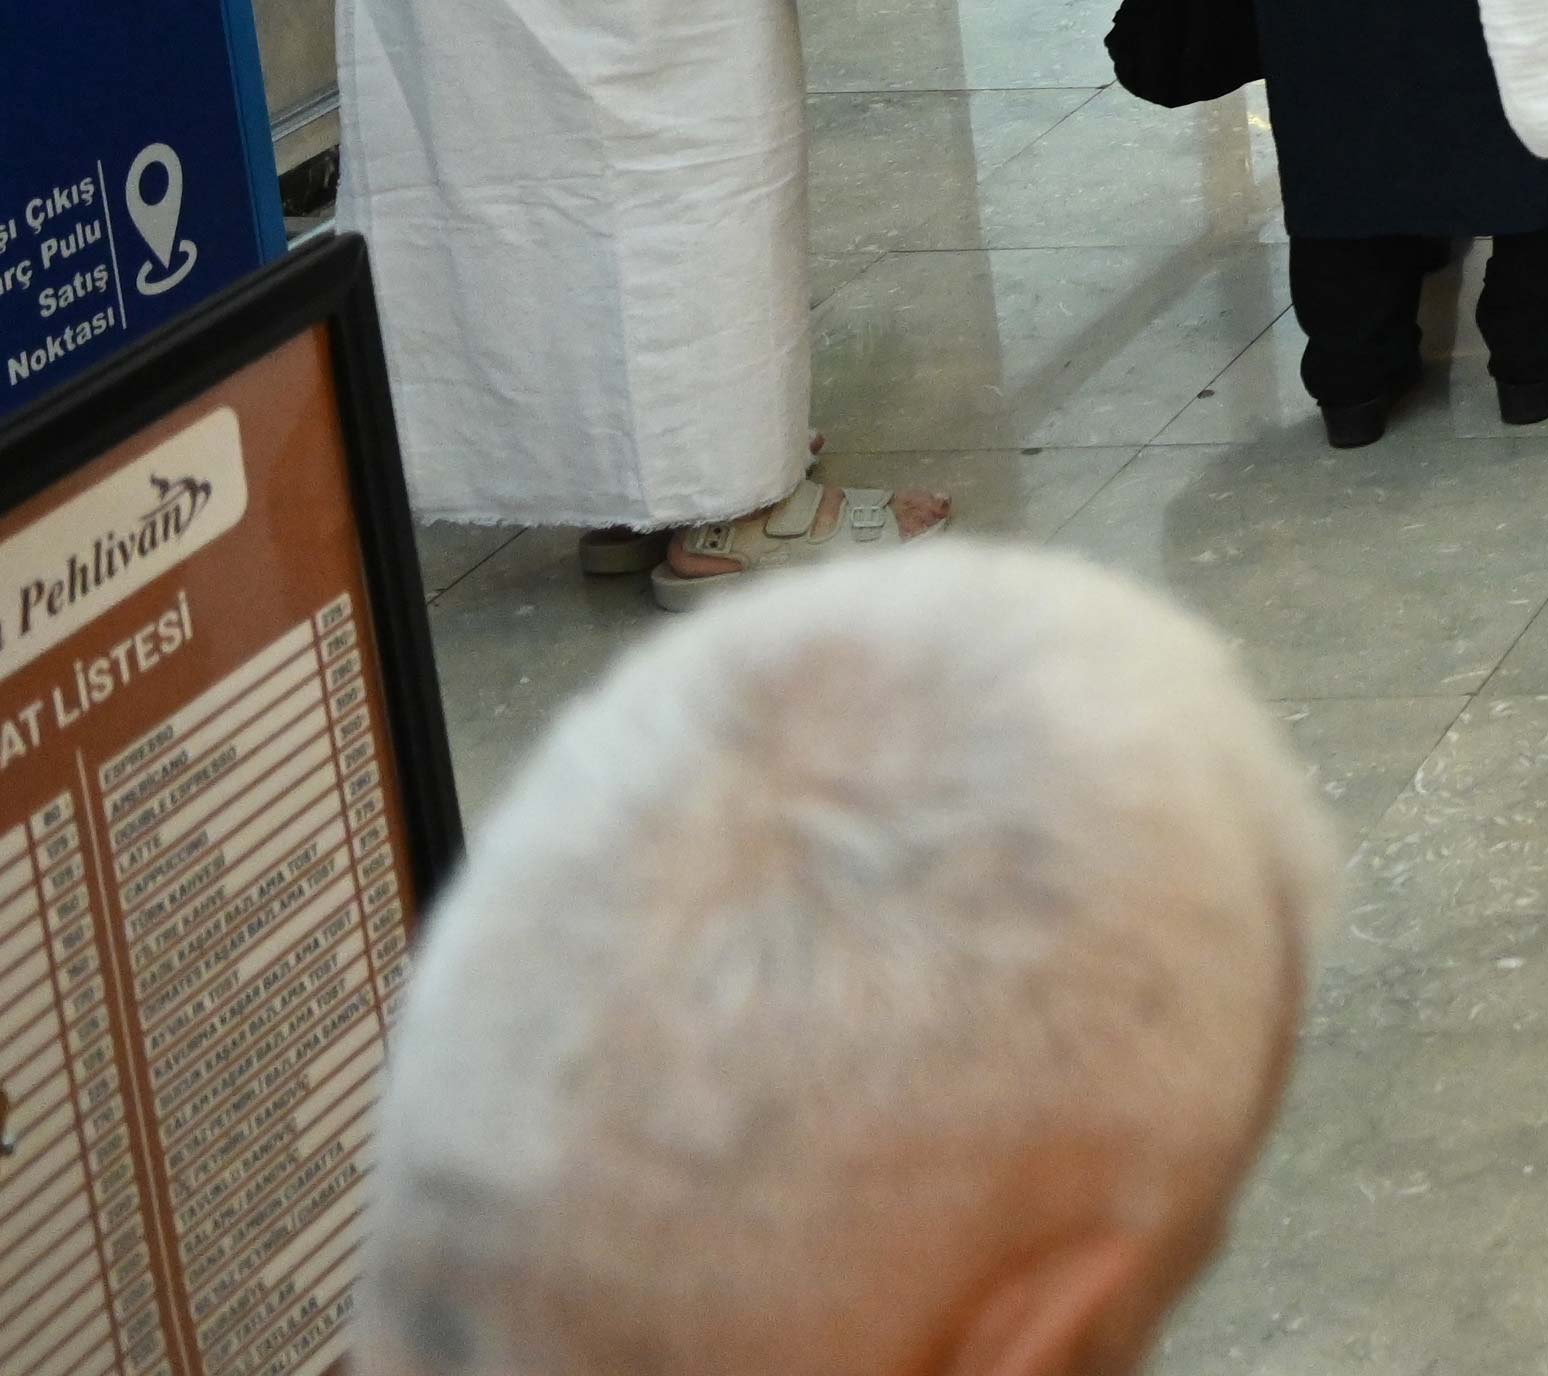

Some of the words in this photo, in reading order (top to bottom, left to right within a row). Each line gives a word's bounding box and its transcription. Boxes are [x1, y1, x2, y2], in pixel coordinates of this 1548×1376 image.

[25, 177, 94, 234] Çıkış
[41, 219, 102, 269] Pulu
[39, 264, 108, 318] Satış
[7, 307, 114, 386] Noktası
[19, 501, 186, 636] Pehlivan
[53, 589, 194, 730] LİSTESİ
